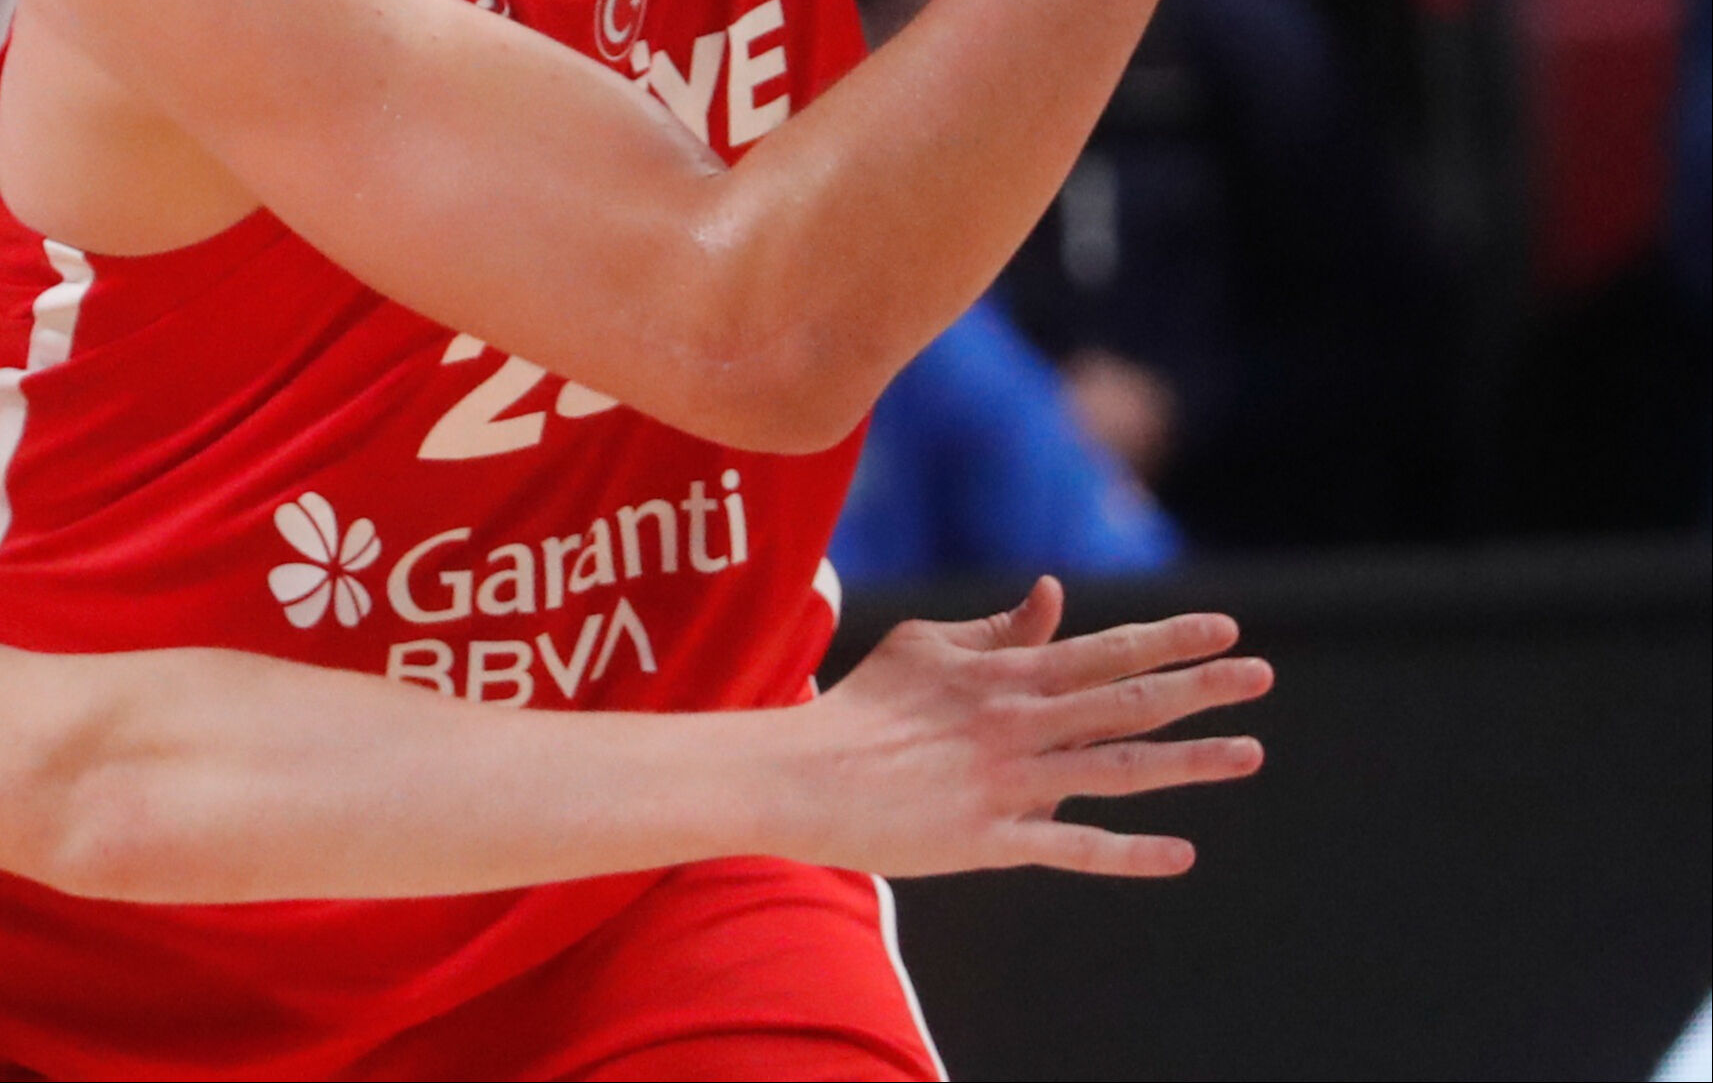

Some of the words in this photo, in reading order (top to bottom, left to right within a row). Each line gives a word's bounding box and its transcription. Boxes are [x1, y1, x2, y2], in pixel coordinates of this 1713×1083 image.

[417, 332, 621, 461] 2
[386, 468, 748, 624] Garanti
[384, 596, 657, 709] BBVA
